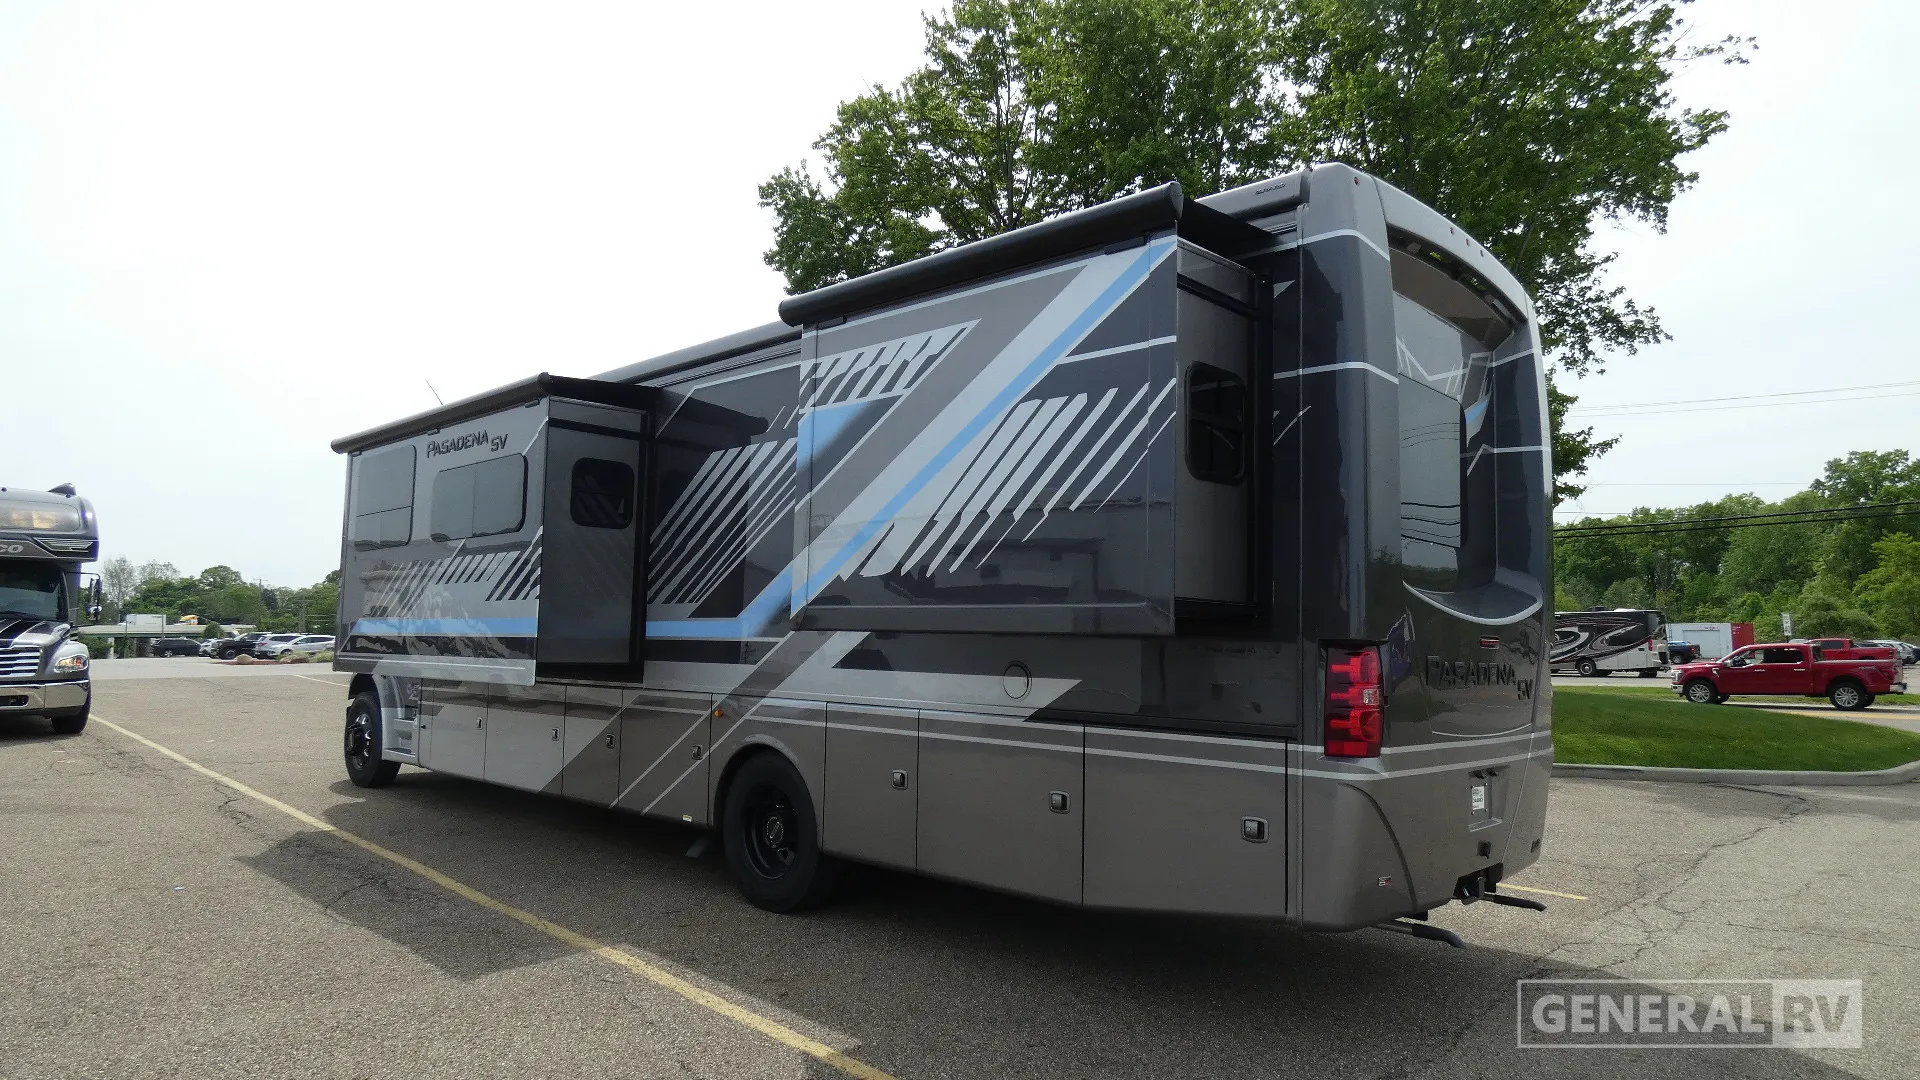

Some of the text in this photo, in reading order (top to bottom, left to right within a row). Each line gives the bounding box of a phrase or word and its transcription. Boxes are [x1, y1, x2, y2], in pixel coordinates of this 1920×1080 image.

[427, 430, 509, 458] PASADENA SV
[1425, 655, 1517, 687] PASADENA
